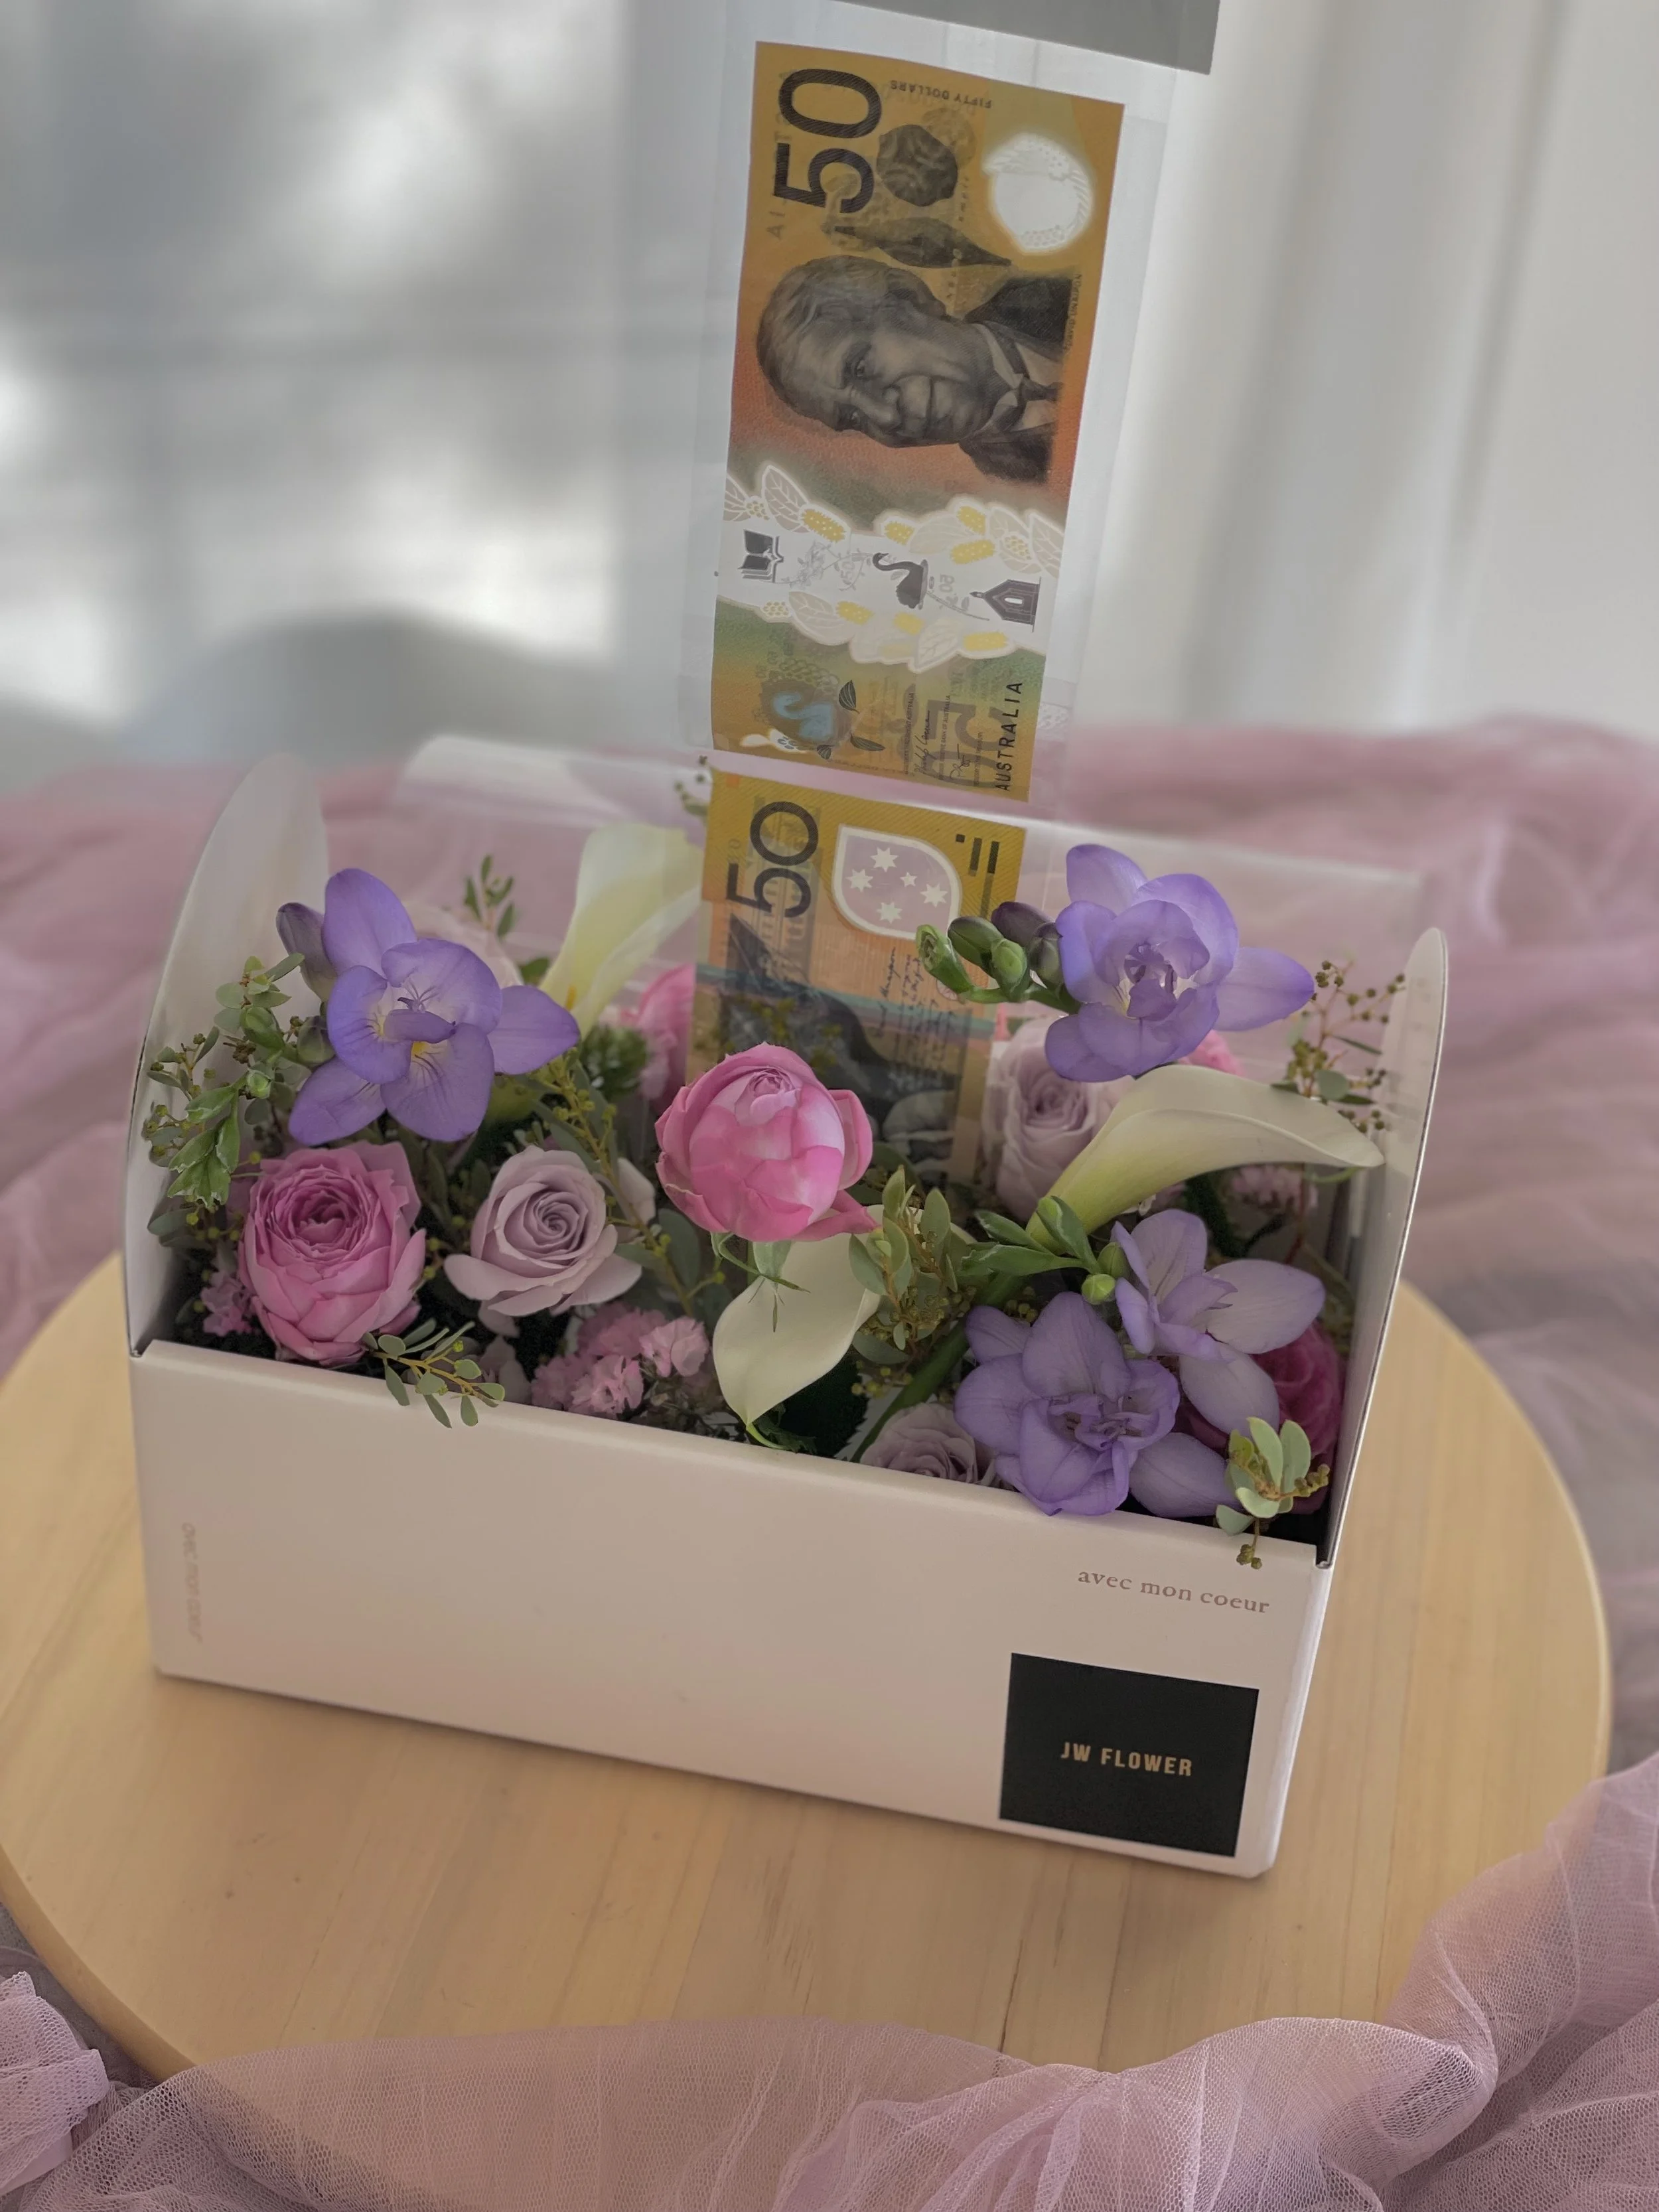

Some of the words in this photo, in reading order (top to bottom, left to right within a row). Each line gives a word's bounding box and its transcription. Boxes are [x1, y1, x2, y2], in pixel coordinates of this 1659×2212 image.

[889, 80, 950, 100] DOLLARS
[953, 93, 993, 110] FIFTY
[772, 68, 883, 214] 50
[995, 682, 1023, 791] AUSTRALIA
[725, 801, 818, 917] 50
[1078, 1571, 1132, 1591] avec
[1140, 1581, 1192, 1601] mon
[1200, 1592, 1269, 1614] coeur
[1060, 1742, 1091, 1763] JW
[1101, 1748, 1192, 1777] FLOWER
